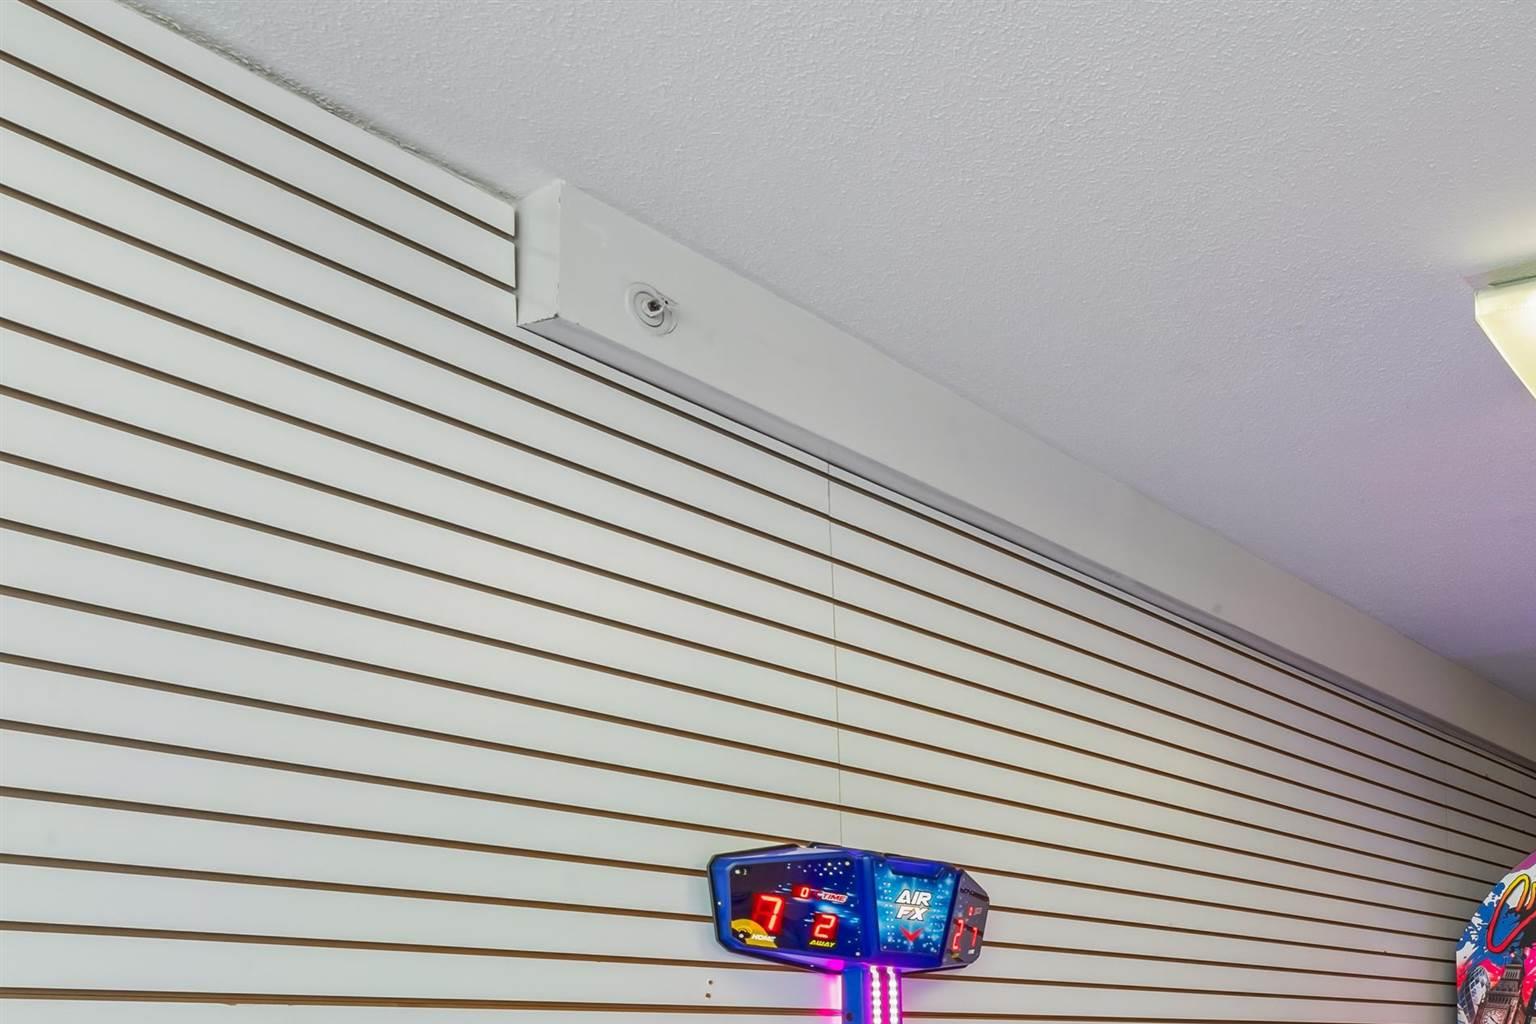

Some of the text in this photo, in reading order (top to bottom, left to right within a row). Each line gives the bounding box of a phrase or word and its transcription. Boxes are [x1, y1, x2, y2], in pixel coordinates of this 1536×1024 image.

[821, 891, 847, 903] TIME
[895, 888, 932, 907] AIR
[760, 895, 783, 931] 7
[896, 906, 929, 921] FX
[814, 914, 837, 939] 2
[809, 939, 836, 948] AWAY
